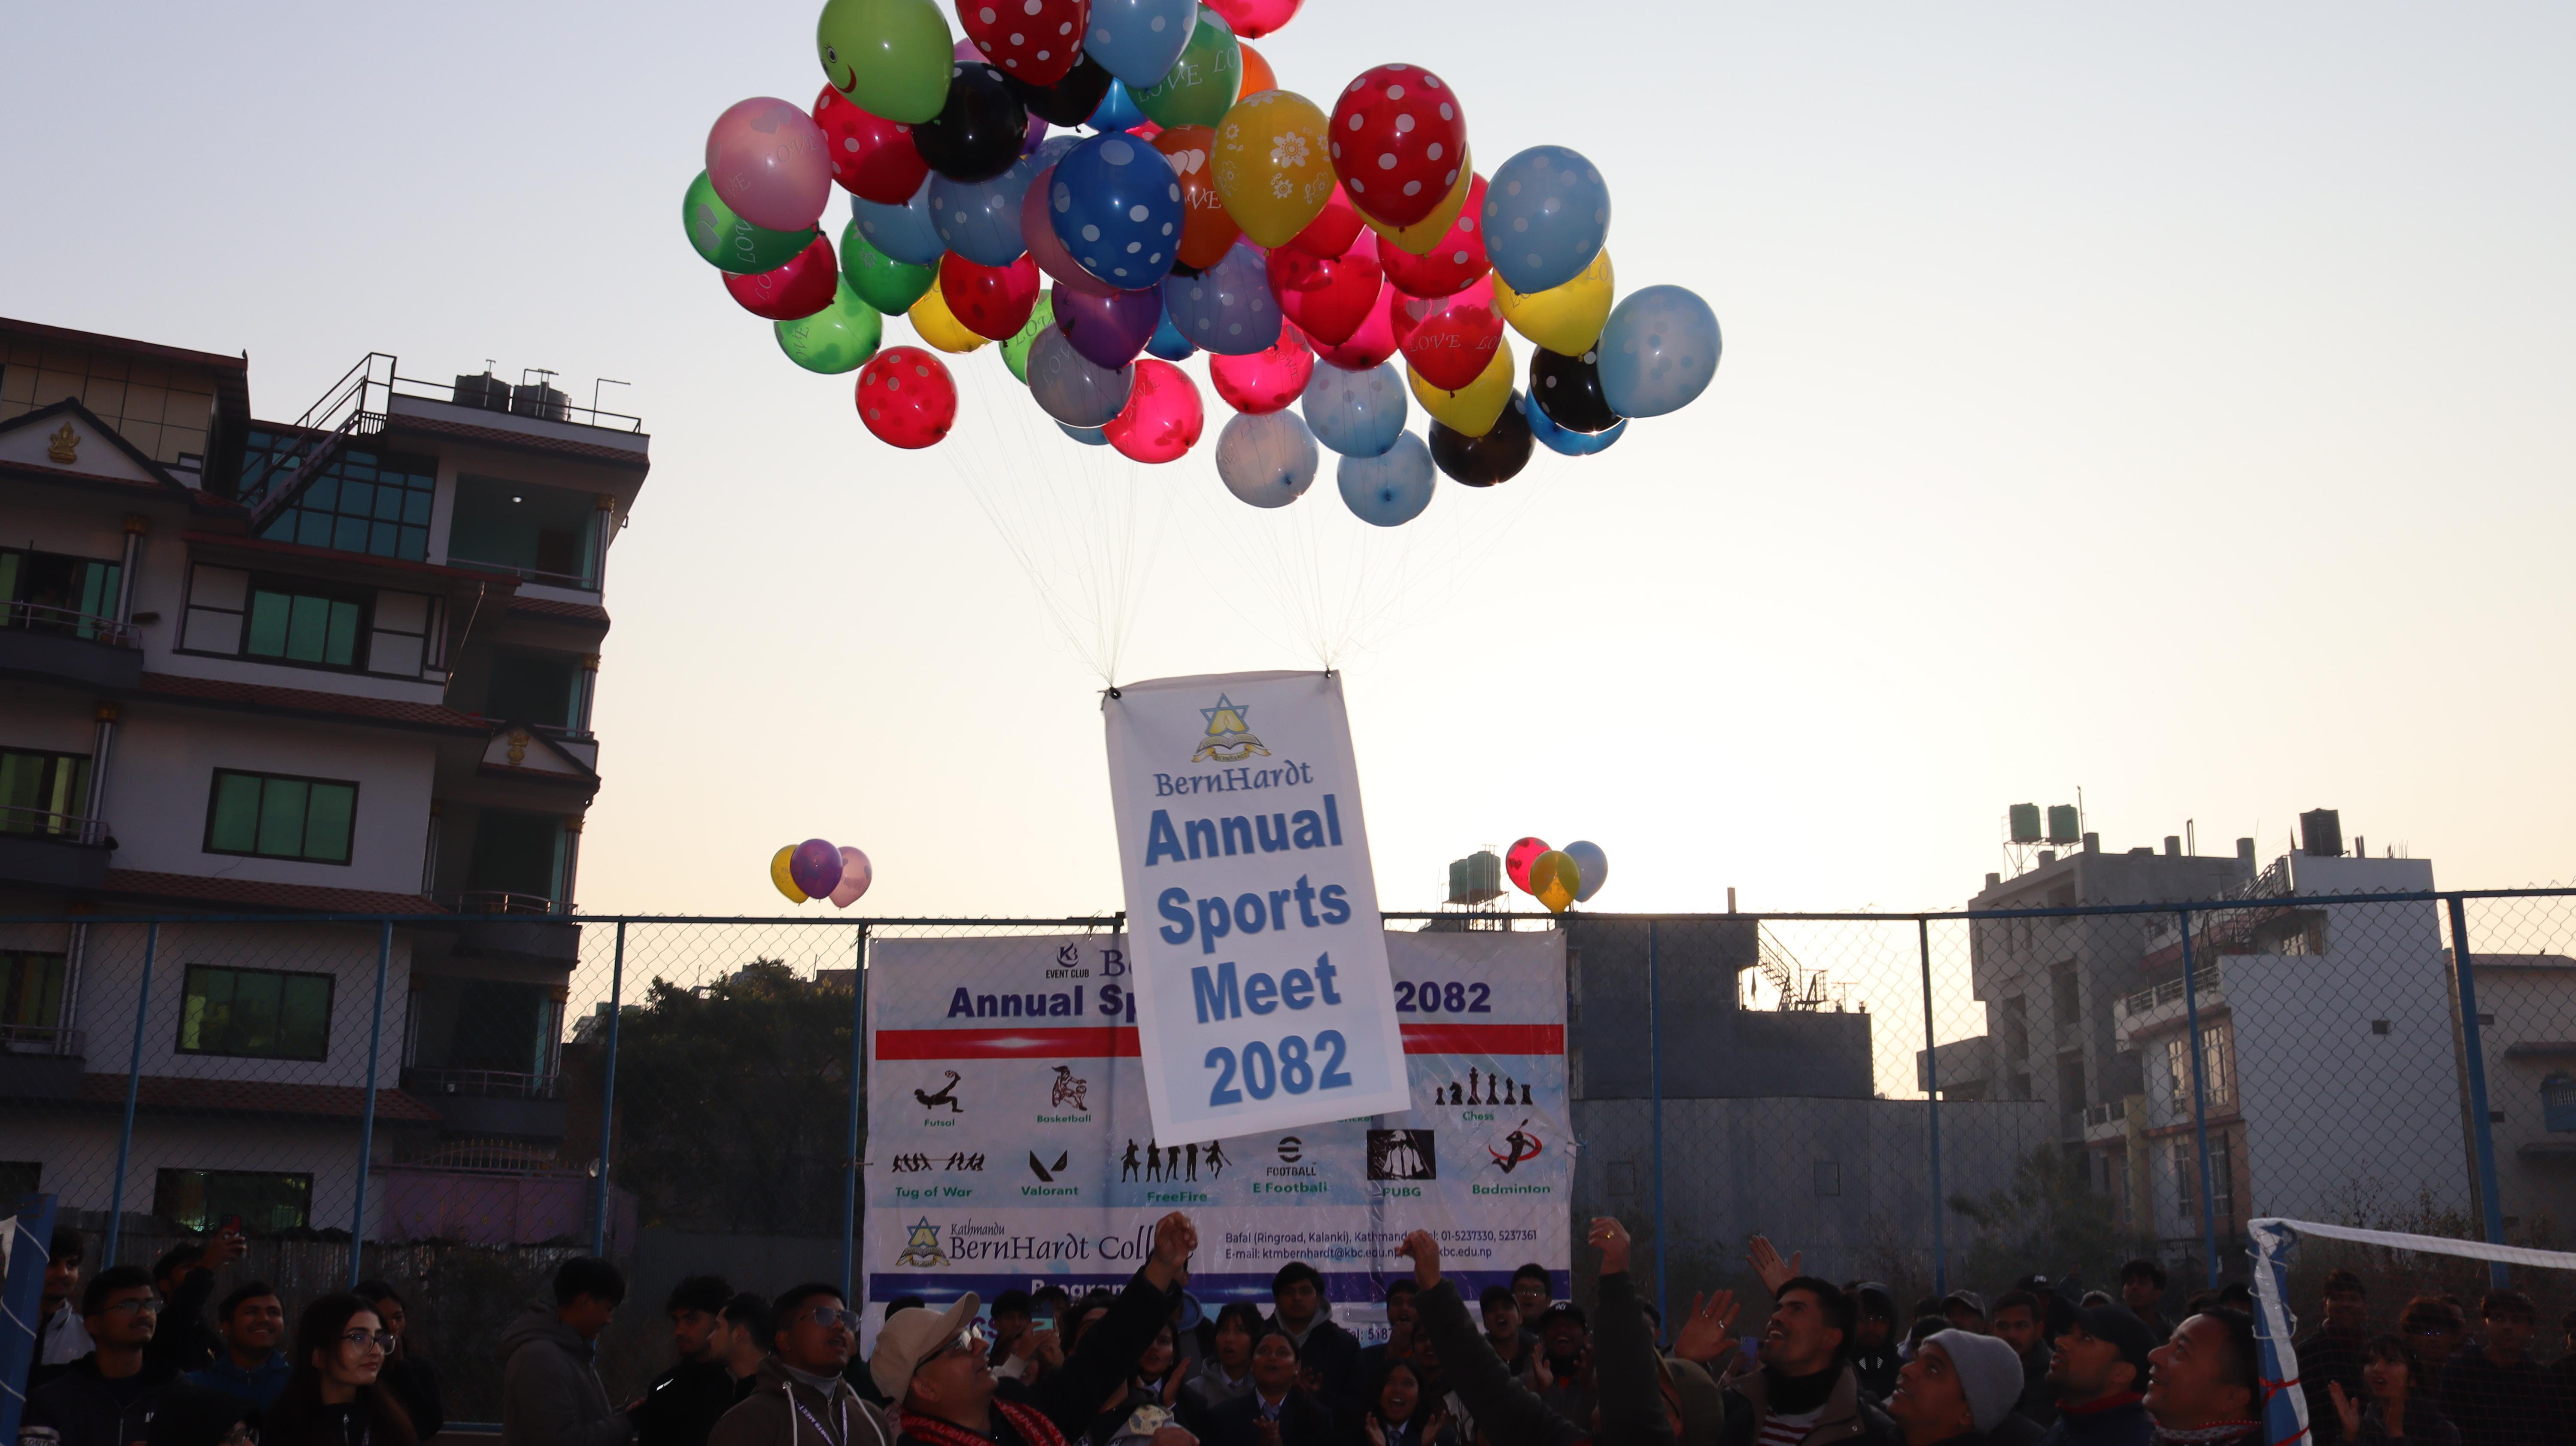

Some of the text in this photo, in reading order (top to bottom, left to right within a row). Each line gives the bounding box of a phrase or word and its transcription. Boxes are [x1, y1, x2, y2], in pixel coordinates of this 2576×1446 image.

[765, 134, 818, 175] LOVE
[1410, 333, 1461, 352] LOVE
[1153, 760, 1313, 796] BernHardt
[1145, 794, 1343, 867] Annual
[1158, 874, 1351, 955] Sports
[1046, 969, 1089, 978] EVENT CLUB
[1191, 951, 1341, 1024] Meet
[947, 985, 1083, 1018] Annual
[1394, 981, 1491, 1013] 2082
[1204, 1030, 1352, 1107] 2082
[924, 1118, 955, 1127] Futsal
[1037, 1114, 1091, 1123] Basketball
[1463, 1111, 1494, 1121] Chess
[1267, 1167, 1316, 1177] FOOTBALL
[896, 1186, 972, 1200] Tug of War
[1021, 1186, 1078, 1196] Valorant
[1253, 1182, 1327, 1193] E Football
[1382, 1187, 1421, 1197] PUBG
[1472, 1184, 1551, 1195] Badminton
[1147, 1191, 1207, 1202] FreeFire
[951, 1218, 1005, 1238] Kathmandu
[1226, 1232, 1251, 1243] Bafal
[1254, 1232, 1306, 1245] (Ringroad,
[1309, 1231, 1352, 1244] Kalanki),
[1355, 1230, 1407, 1242] Kathmand
[1441, 1230, 1496, 1242] 01-5237330,
[1499, 1230, 1537, 1241] 5237361
[949, 1233, 1089, 1260] BernHardt
[1226, 1248, 1260, 1259] E-mail:
